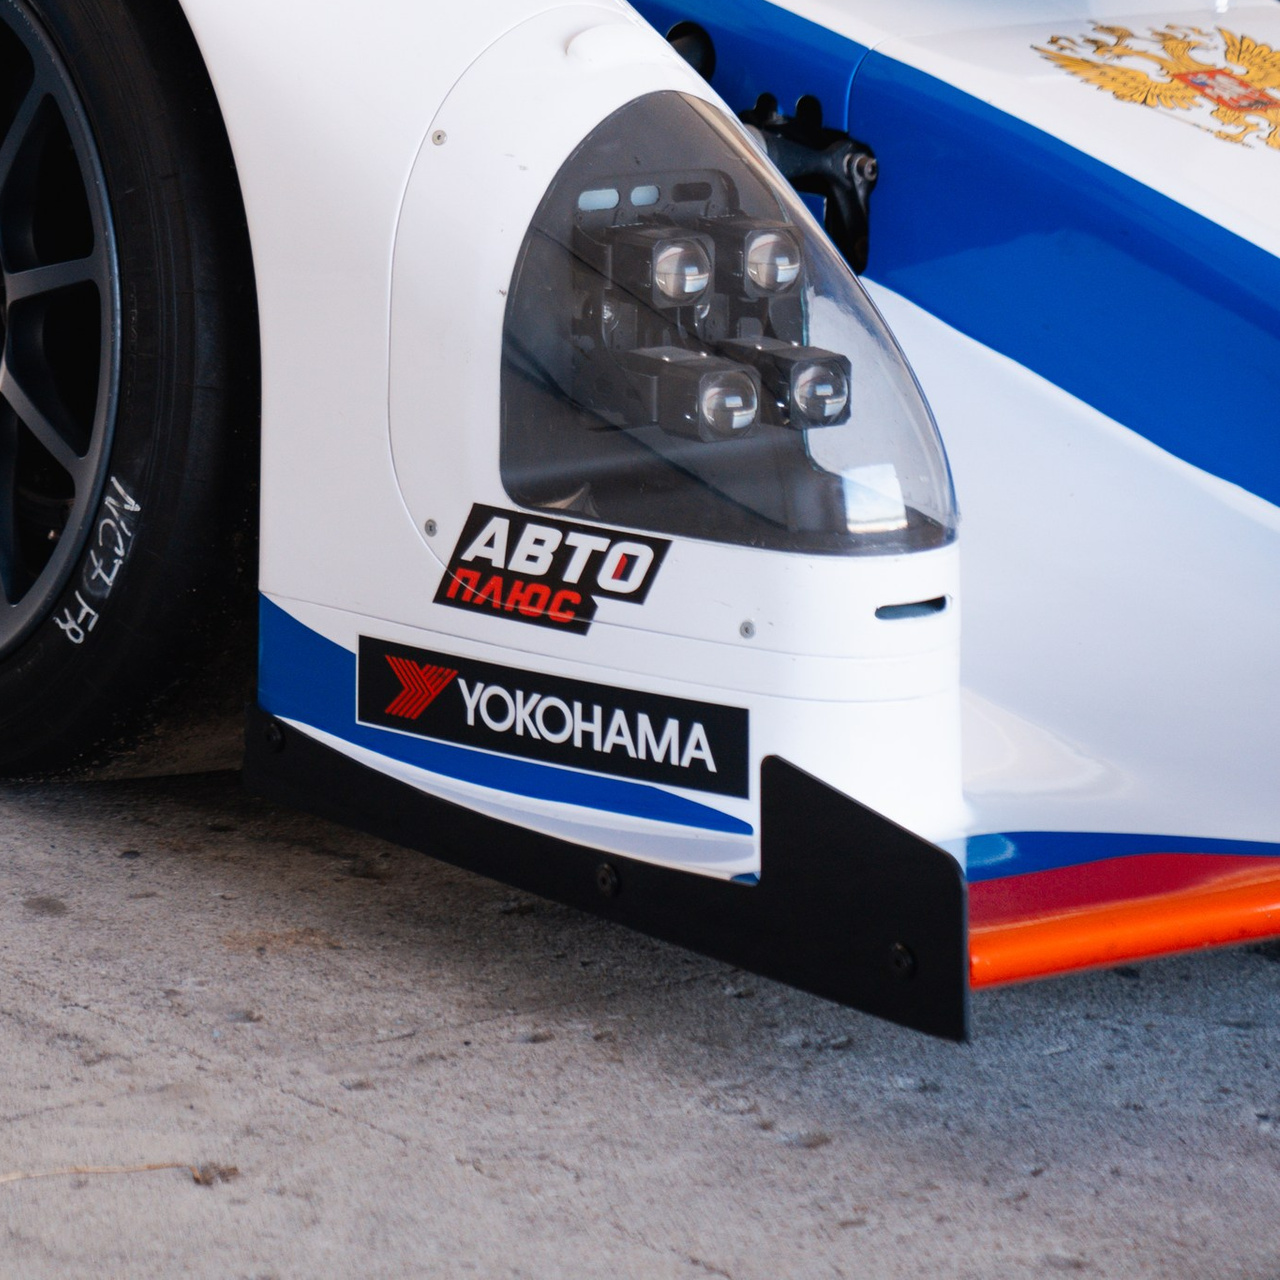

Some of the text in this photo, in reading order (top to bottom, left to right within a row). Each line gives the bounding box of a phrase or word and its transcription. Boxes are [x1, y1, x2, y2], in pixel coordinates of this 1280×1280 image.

[460, 516, 655, 594] АВТО
[446, 567, 582, 623] ПЛЮС
[457, 677, 718, 774] YOKOHAMA
